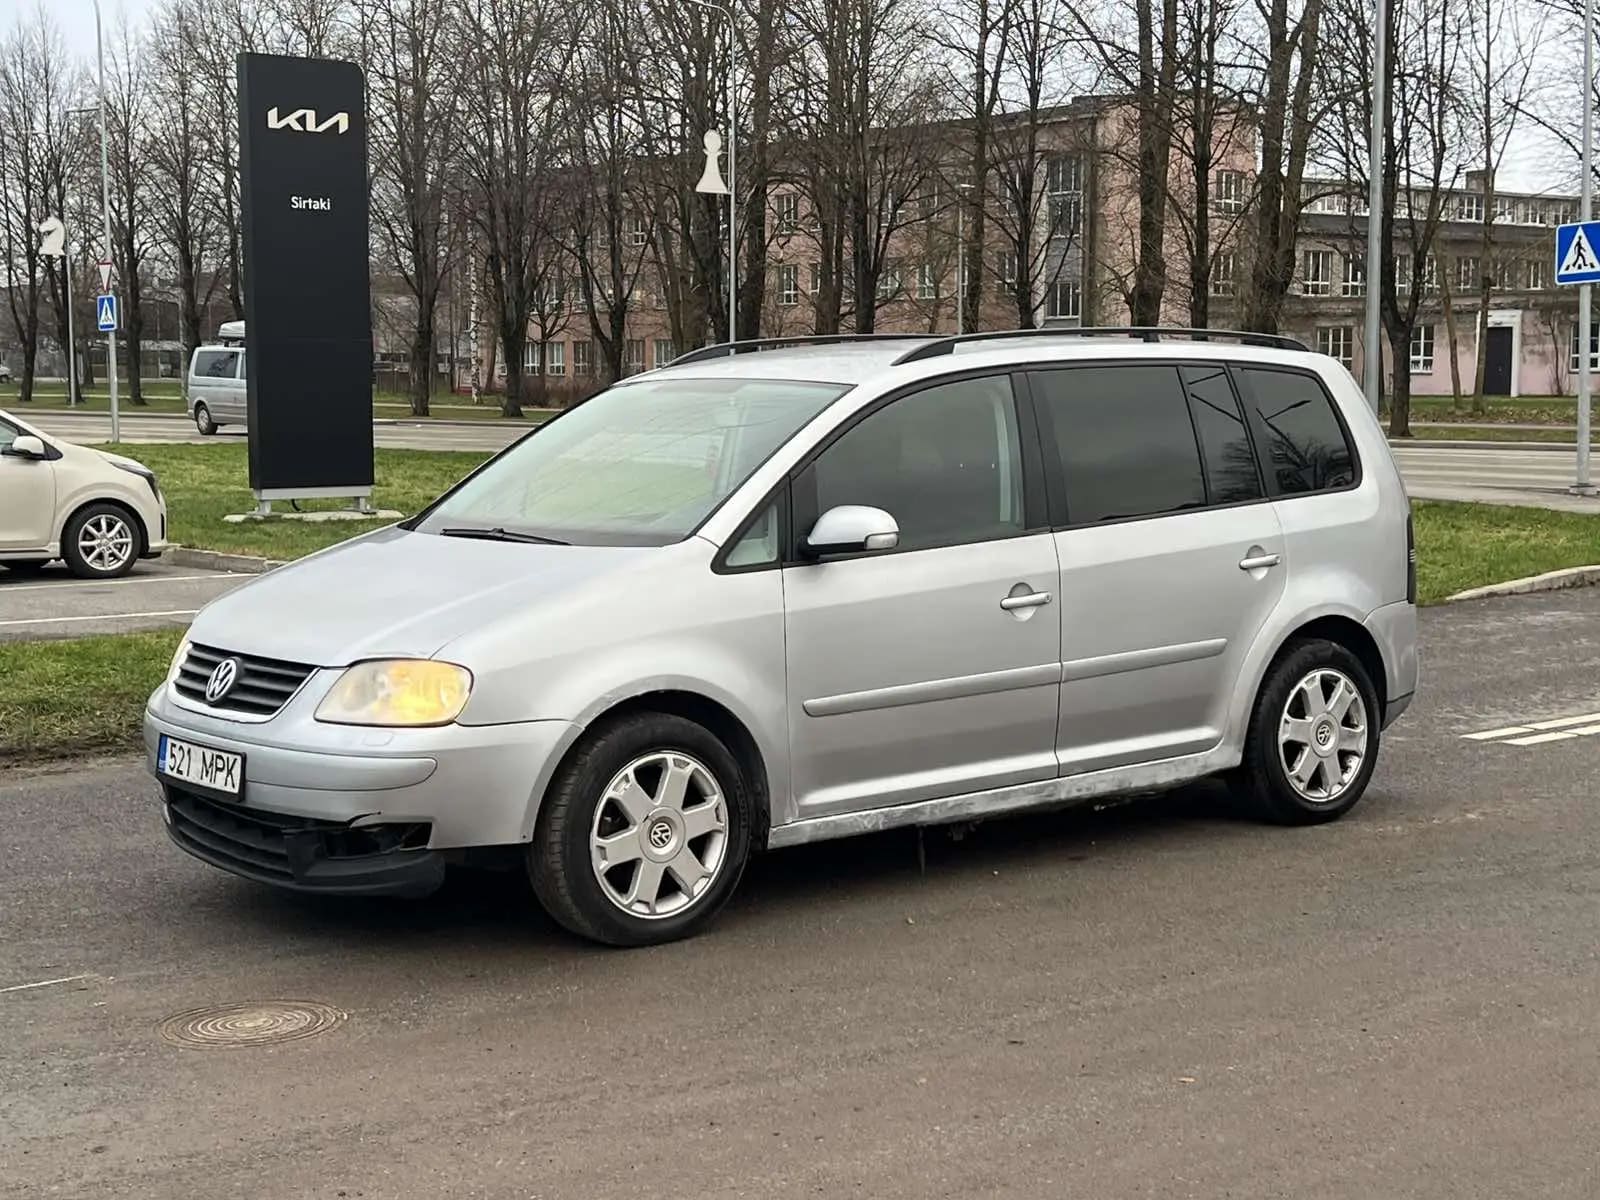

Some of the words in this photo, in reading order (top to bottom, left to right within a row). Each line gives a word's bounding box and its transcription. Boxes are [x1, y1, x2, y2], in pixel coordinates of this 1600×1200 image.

[267, 106, 349, 135] KIA
[290, 195, 331, 210] Sirtaki
[168, 742, 192, 777] 521
[200, 751, 238, 789] MPK
